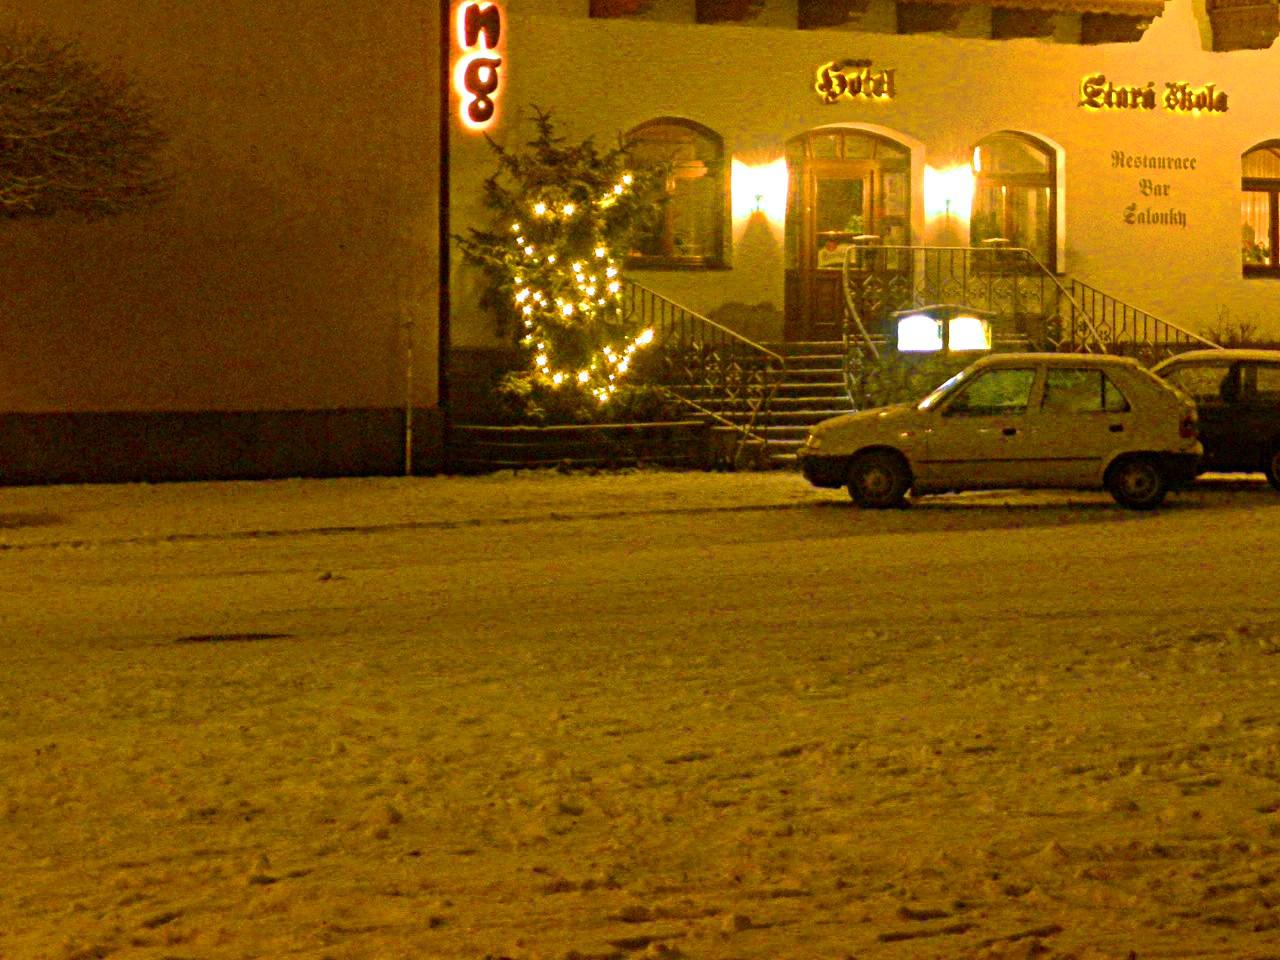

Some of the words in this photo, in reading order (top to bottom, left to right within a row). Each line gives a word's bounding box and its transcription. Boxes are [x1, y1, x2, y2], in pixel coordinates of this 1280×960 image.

[815, 59, 896, 104] Hotel
[1111, 150, 1197, 170] Restaurace
[1139, 178, 1171, 197] Bar
[1123, 202, 1187, 228] Salonky
